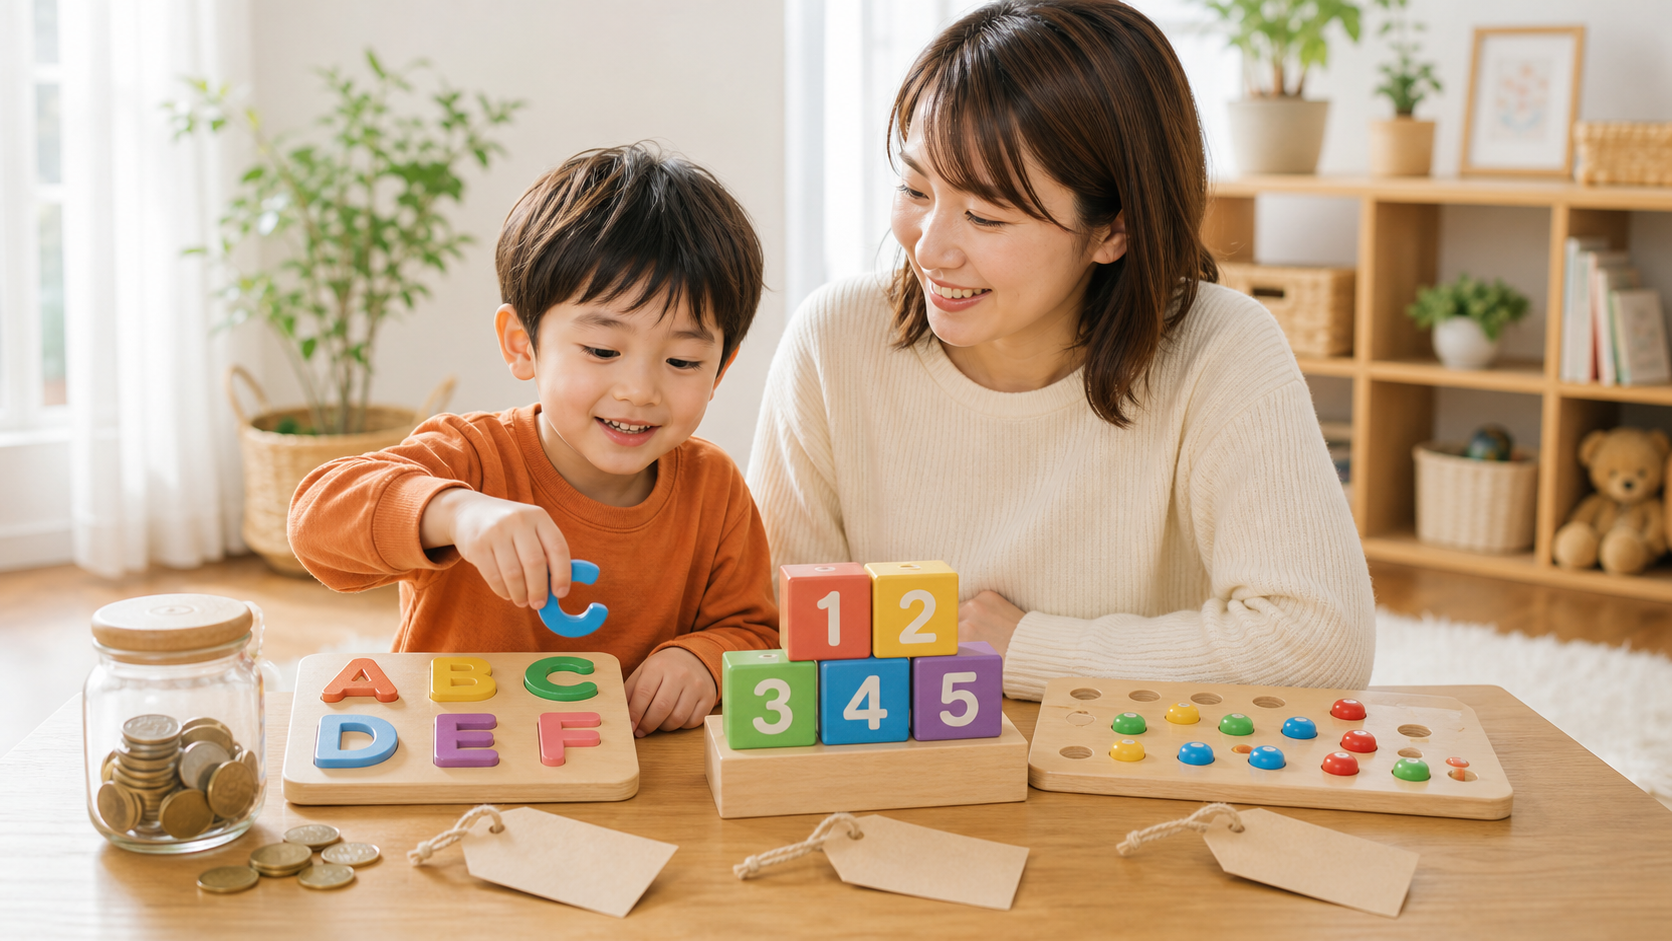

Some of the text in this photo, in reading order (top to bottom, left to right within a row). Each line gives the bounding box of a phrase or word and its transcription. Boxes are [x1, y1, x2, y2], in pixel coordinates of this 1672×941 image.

[538, 559, 609, 638] C
[817, 589, 937, 647] 1 2
[320, 656, 599, 703] A B C
[752, 671, 980, 735] 3 4 5
[314, 712, 601, 768] D E F
